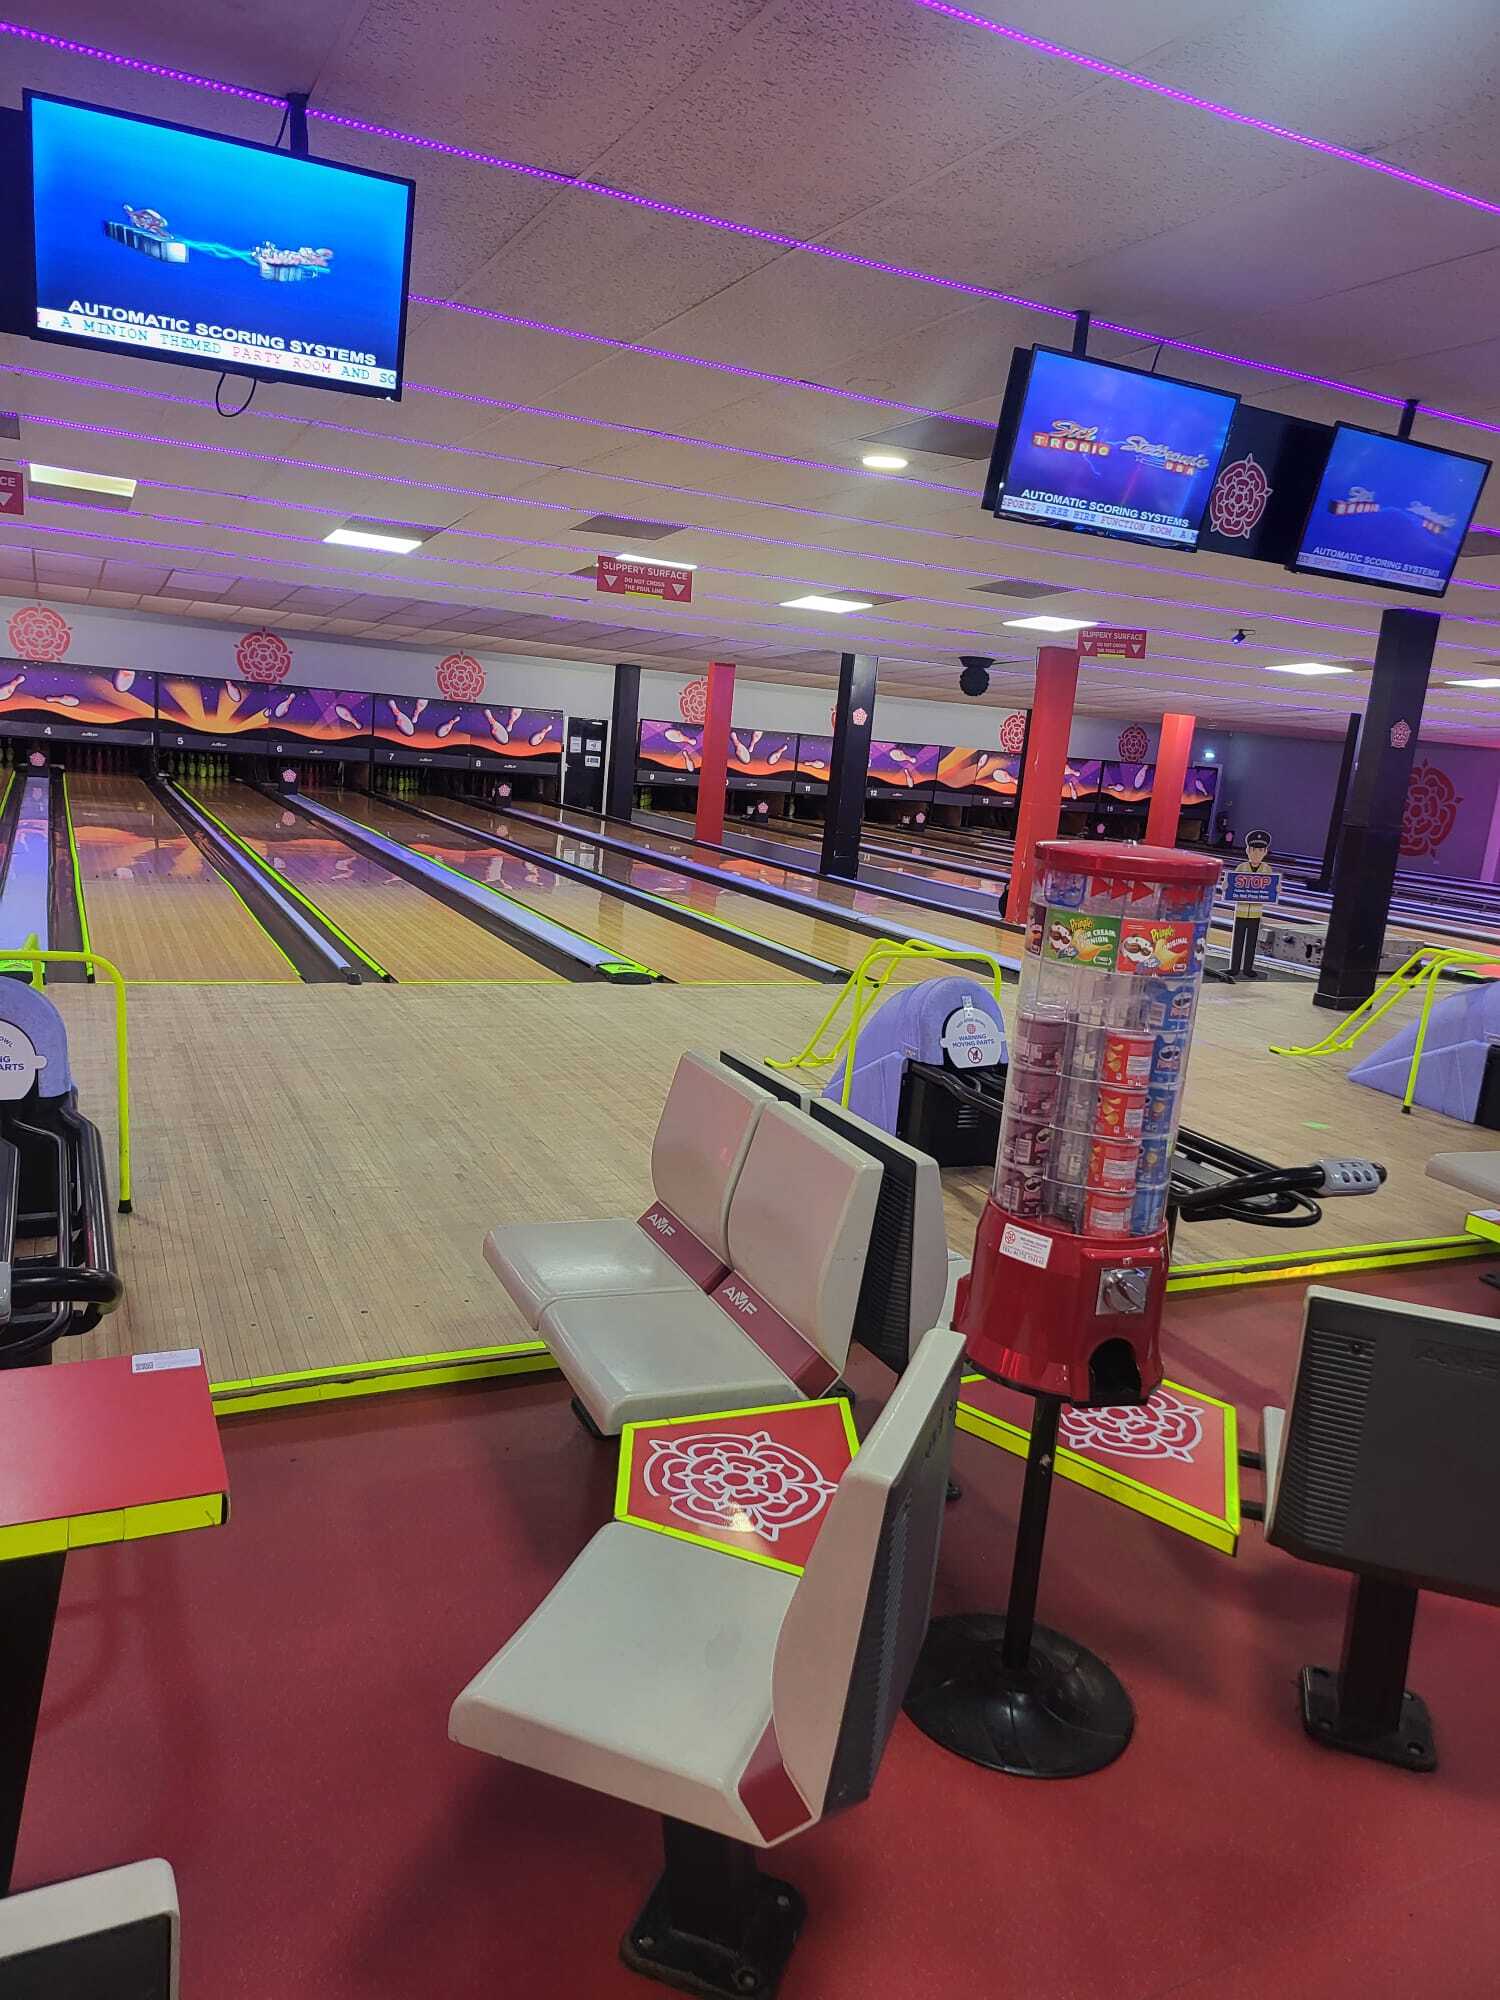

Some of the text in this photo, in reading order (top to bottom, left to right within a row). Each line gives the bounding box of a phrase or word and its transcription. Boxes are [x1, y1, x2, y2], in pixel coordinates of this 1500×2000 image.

[68, 300, 190, 333] AUTOMATIC
[195, 322, 285, 350] SCORING
[289, 340, 377, 366] SYSTEMS
[83, 319, 148, 341] MINION
[159, 333, 222, 354] THEMED
[232, 346, 281, 365] PARTY
[292, 357, 332, 374] ROOM
[340, 366, 370, 380] AND
[1033, 433, 1110, 456] TRONIC
[1021, 489, 1190, 528] AUTOMATIC SCORING SYSTEMS
[1313, 546, 1363, 562] AUTOMATIC
[1363, 556, 1402, 570] SCORING
[1402, 563, 1441, 578] SYSTEMS
[602, 561, 689, 581] SLIPPERY SURFACE
[1113, 632, 1144, 641] SURFACE
[44, 726, 52, 735] 4
[177, 737, 183, 745] 5
[276, 745, 283, 753] 6
[389, 753, 395, 761] 7
[1235, 875, 1272, 889] STOP
[952, 1038, 994, 1048] MOVING PARTS
[959, 1033, 987, 1042] WARNING
[646, 1213, 677, 1237] AMF
[722, 1286, 758, 1316] AMF
